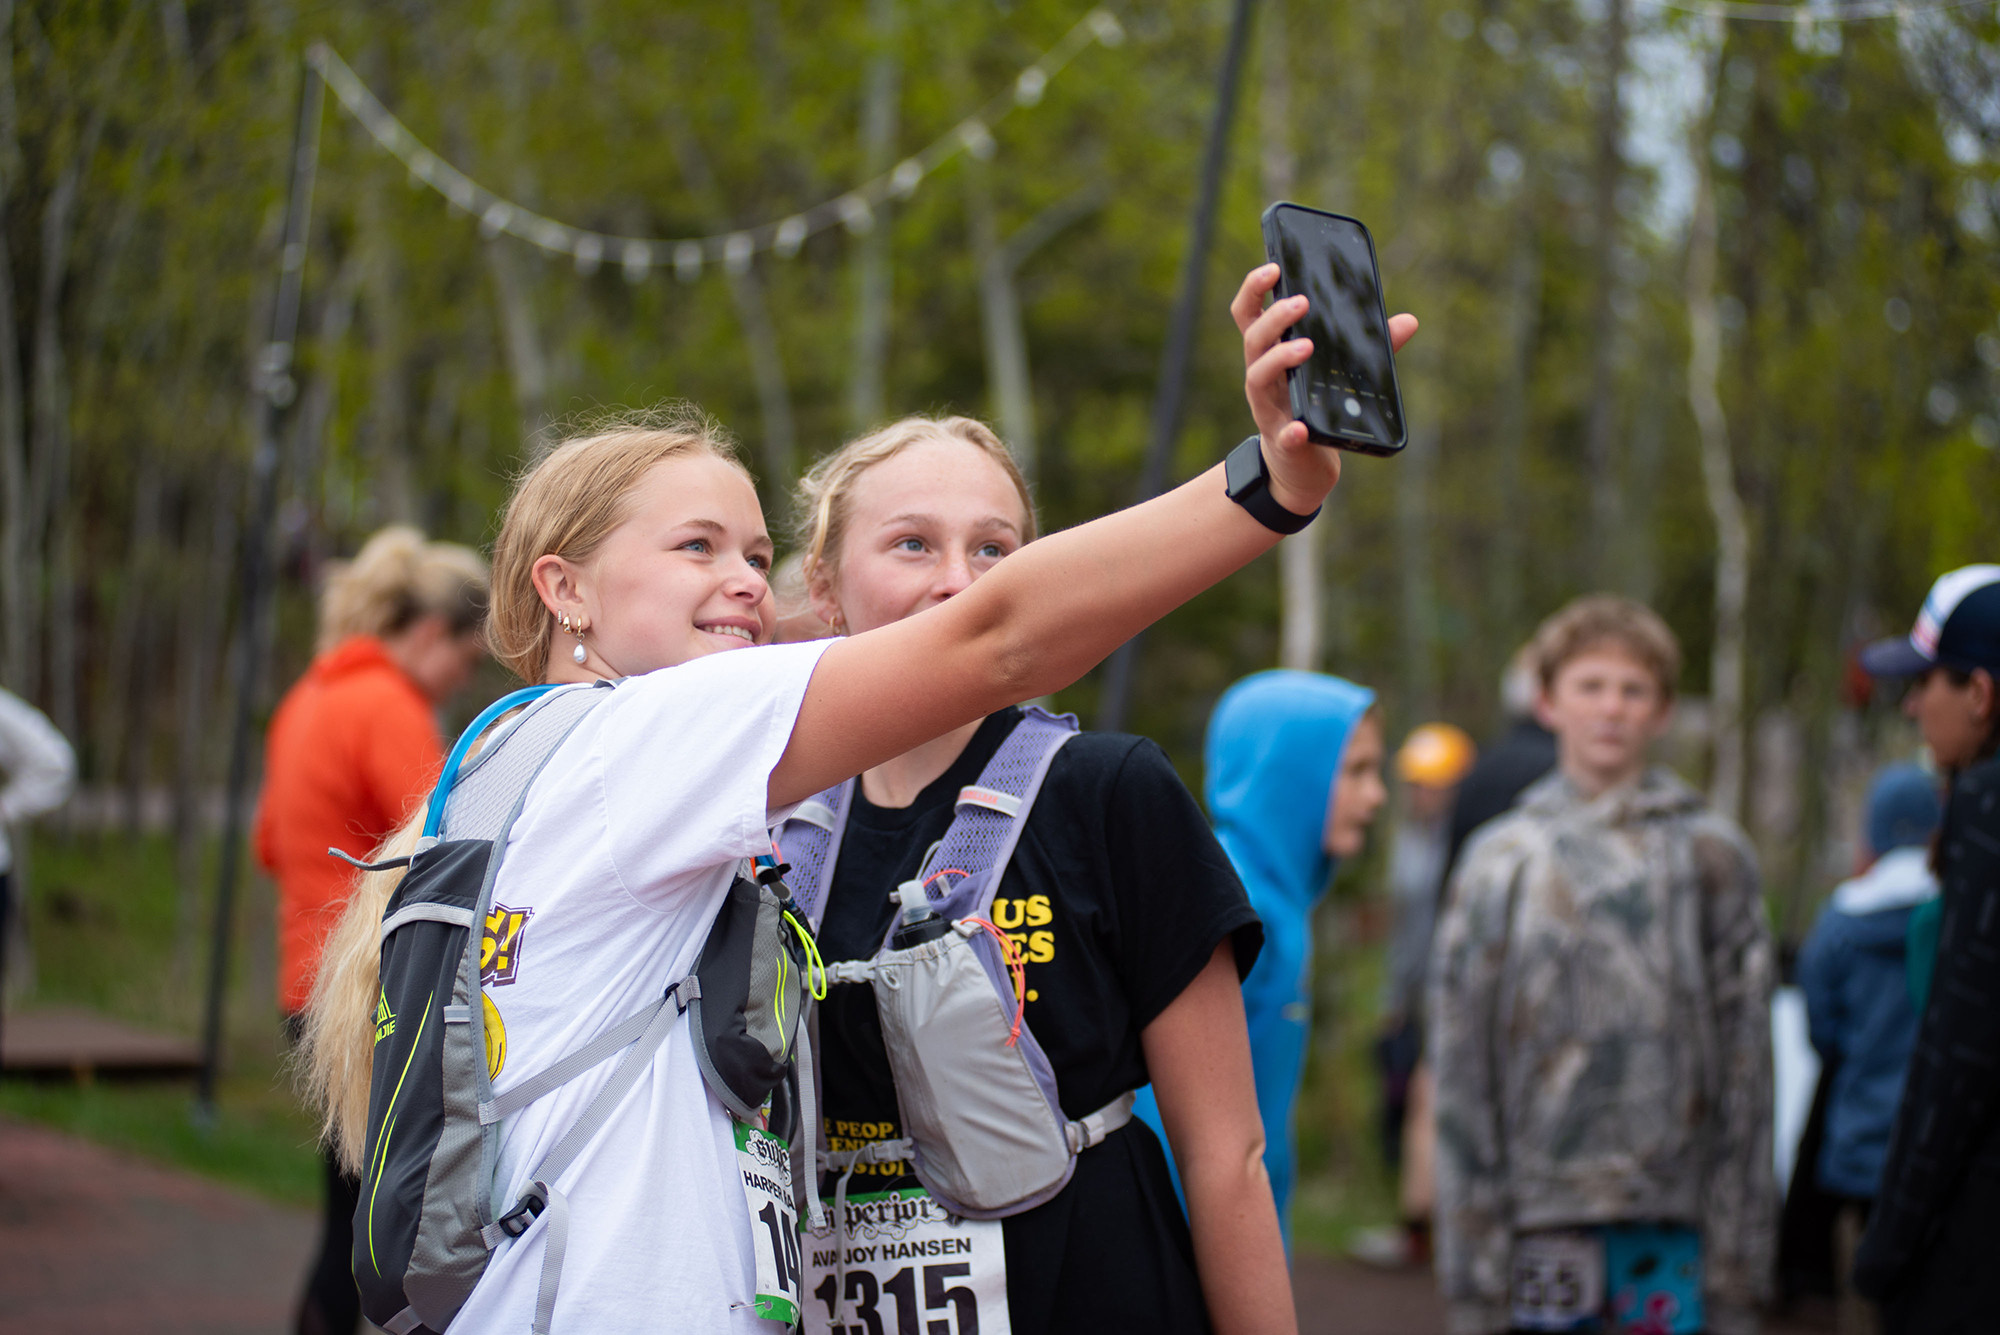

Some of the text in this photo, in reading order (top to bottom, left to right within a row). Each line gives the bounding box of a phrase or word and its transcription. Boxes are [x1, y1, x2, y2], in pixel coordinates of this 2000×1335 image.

[992, 894, 1053, 929] US
[1000, 930, 1055, 965] ES
[836, 1121, 898, 1139] PEOP
[759, 1200, 801, 1304] 14
[812, 1237, 972, 1268] AVA JOY HANSEN
[814, 1262, 979, 1335] 1315
